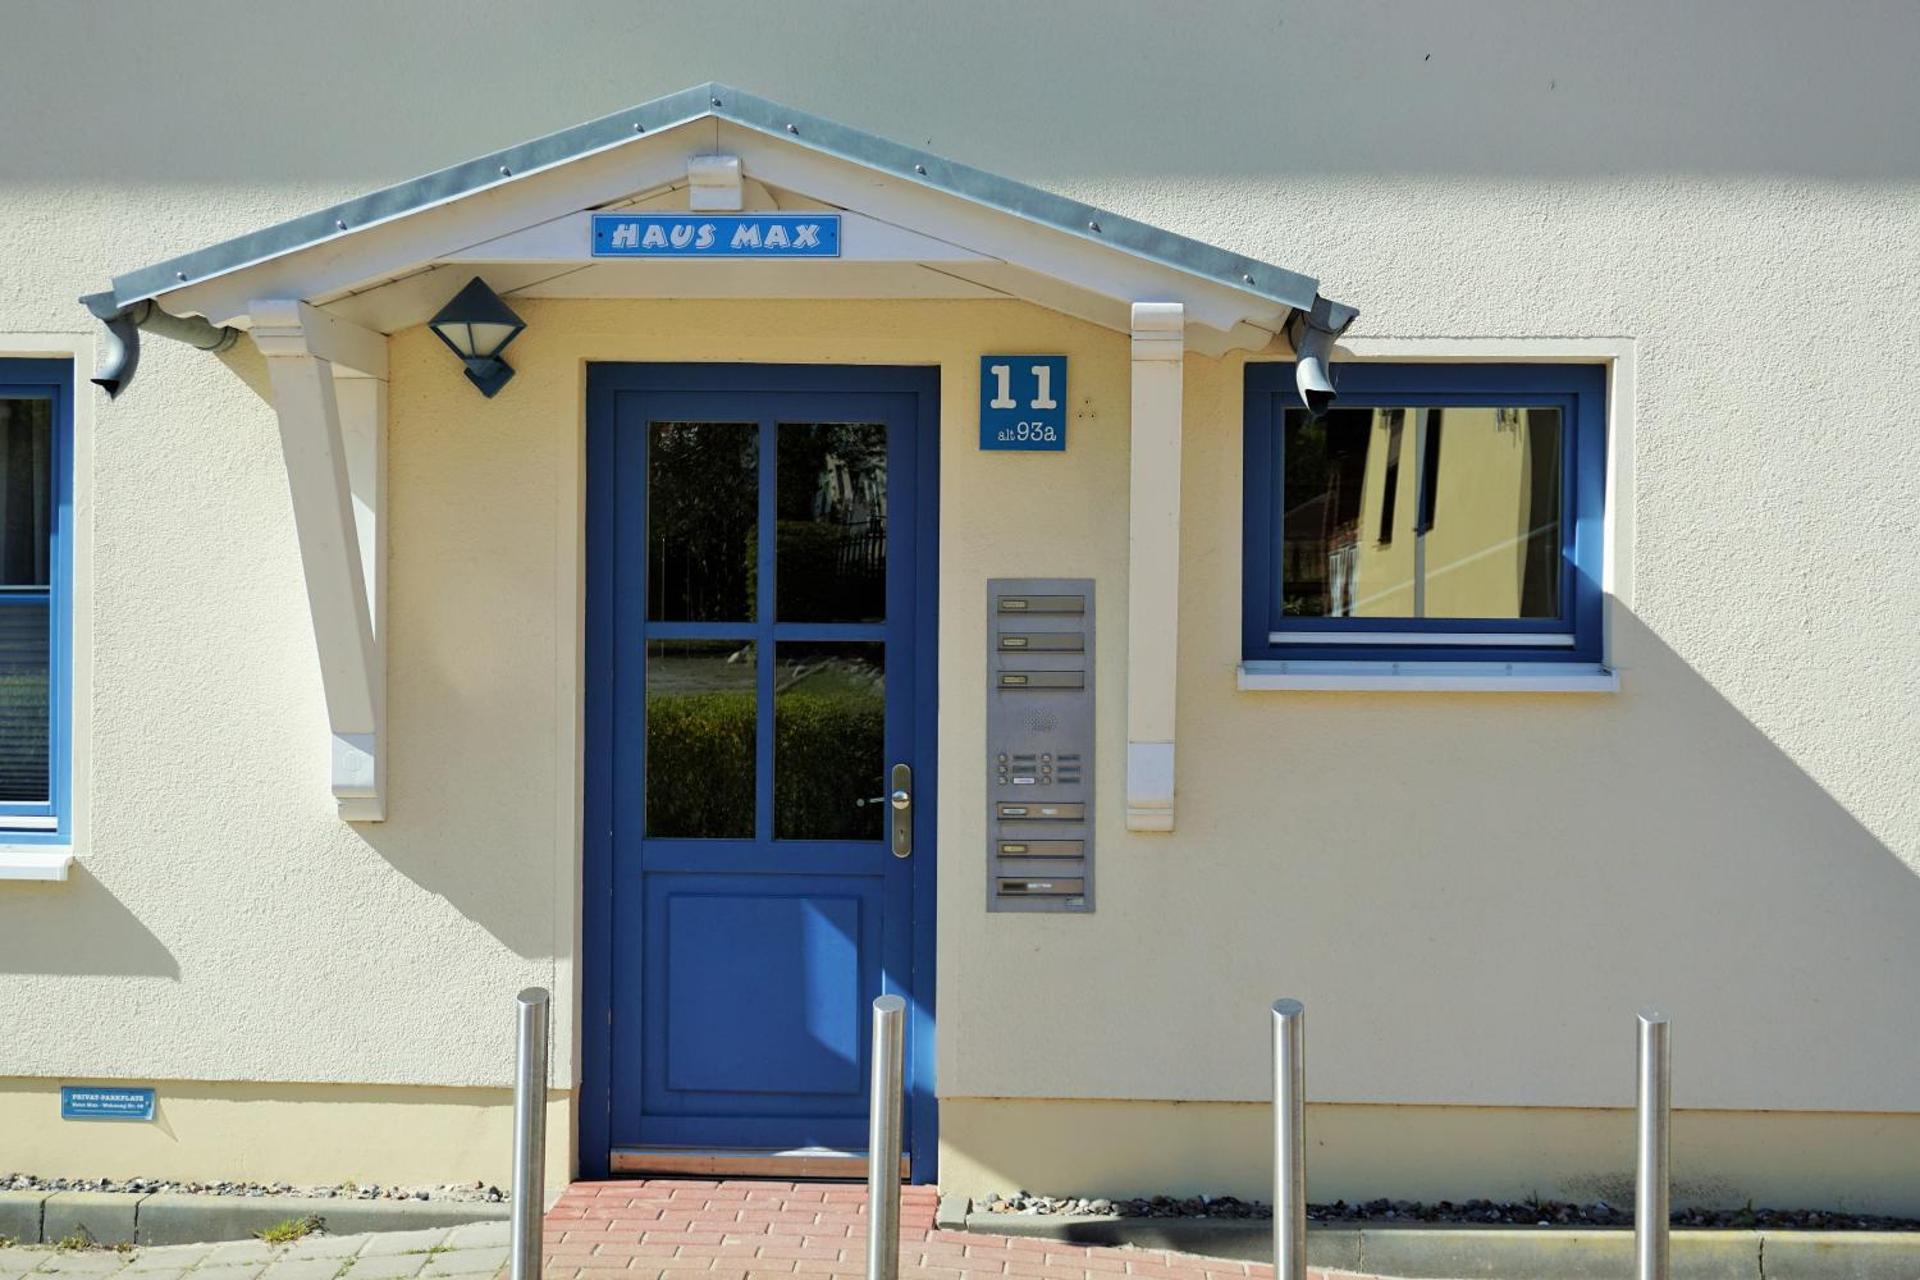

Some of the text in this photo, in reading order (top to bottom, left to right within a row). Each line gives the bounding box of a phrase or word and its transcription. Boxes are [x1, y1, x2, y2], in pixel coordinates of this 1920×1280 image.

[612, 223, 821, 249] HAUS MAX
[990, 365, 1057, 409] 11
